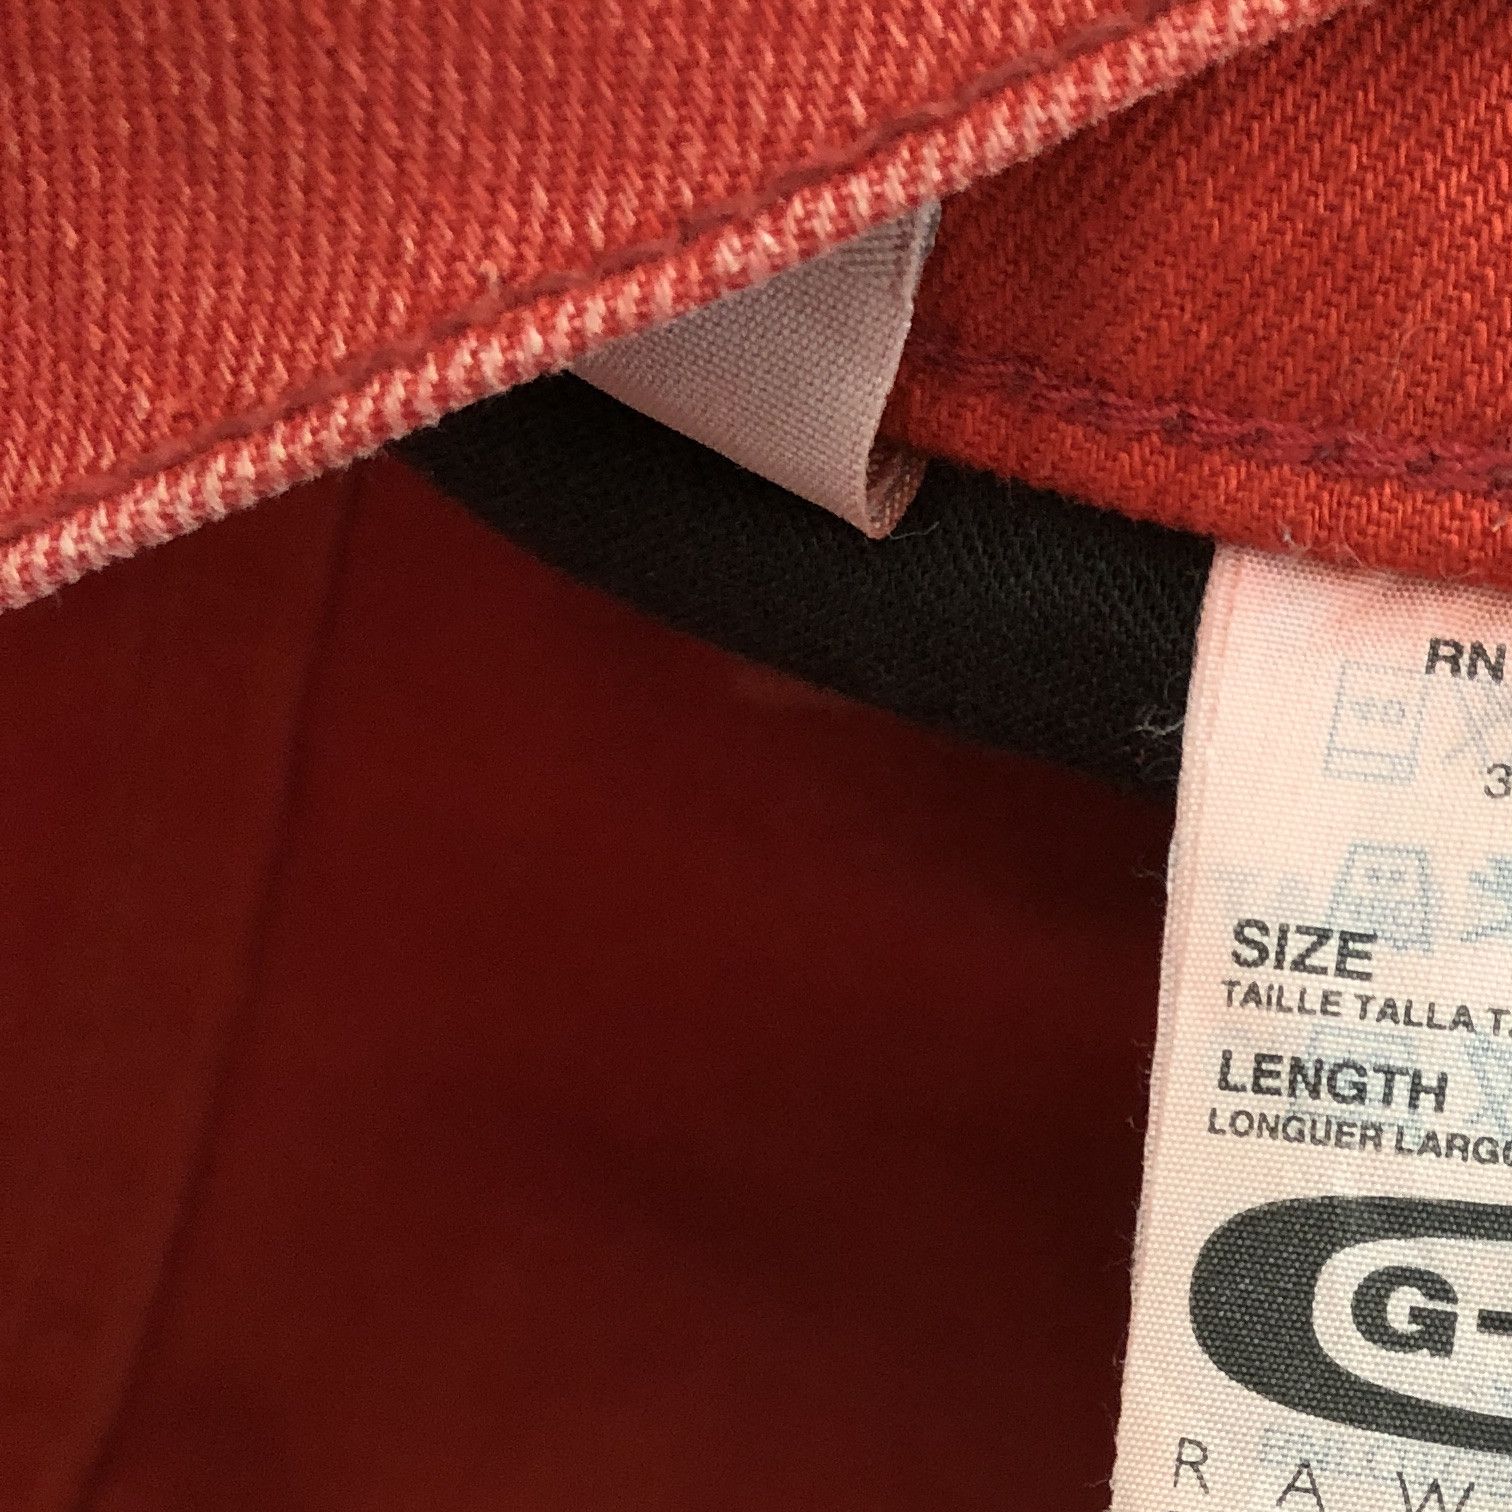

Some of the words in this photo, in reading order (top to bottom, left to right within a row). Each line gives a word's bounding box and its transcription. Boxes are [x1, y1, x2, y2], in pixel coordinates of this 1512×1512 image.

[1426, 638, 1506, 683] RN
[1231, 918, 1379, 981] SIZE
[1221, 980, 1343, 1016] TAILLE
[1354, 993, 1476, 1033] TALLA
[1217, 1049, 1448, 1113] LENGTH
[1207, 1107, 1383, 1152] LONGUER
